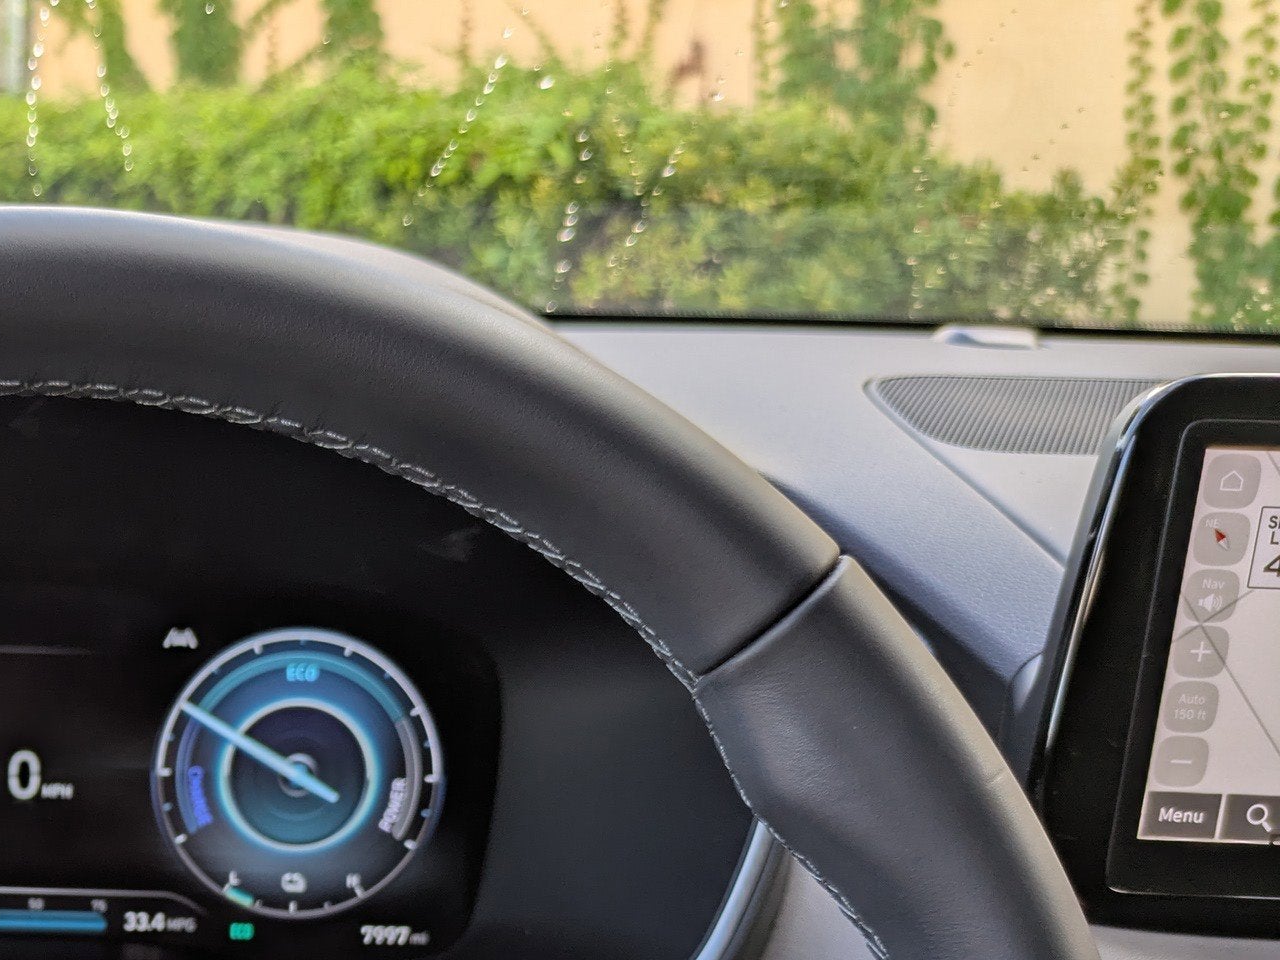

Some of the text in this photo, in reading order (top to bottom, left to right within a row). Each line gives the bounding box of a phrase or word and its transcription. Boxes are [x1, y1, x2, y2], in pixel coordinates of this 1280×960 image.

[1202, 580, 1225, 589] Nav
[286, 663, 318, 682] ECO
[1177, 694, 1205, 705] Auto
[1197, 710, 1207, 720] ft
[7, 749, 74, 800] 0 MPH
[1158, 807, 1205, 824] Menu
[123, 911, 166, 932] 33.4
[360, 924, 411, 945] 7997
